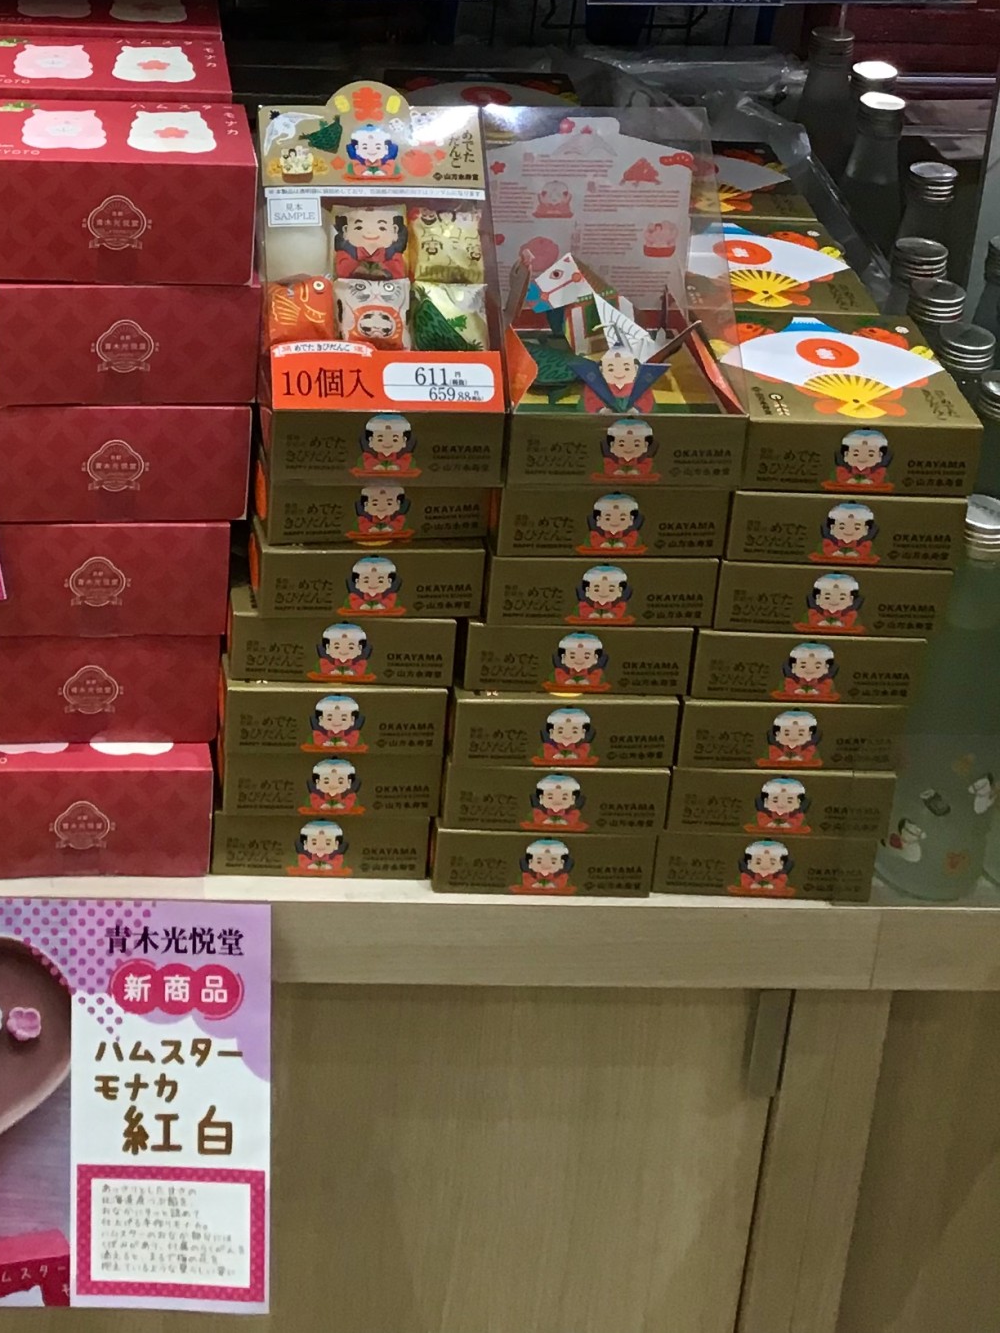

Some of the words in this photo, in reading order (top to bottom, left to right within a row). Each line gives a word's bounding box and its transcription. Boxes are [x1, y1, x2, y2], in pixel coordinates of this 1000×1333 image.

[462, 129, 475, 163] めでた
[286, 203, 303, 211] 見本
[274, 212, 316, 221] SAMPLE
[415, 367, 448, 386] 611
[282, 368, 374, 398] 10個入
[432, 445, 491, 453] OKAYAMA
[673, 449, 732, 458] OKAYAMA
[908, 459, 966, 469] OKAYAMA
[424, 504, 480, 514] OKAYAMA
[659, 522, 715, 531] OKAYAMA
[893, 534, 951, 543] OKAYAMA
[416, 584, 472, 593] OKAYAMA
[646, 594, 703, 602] OKAYAMA
[877, 603, 935, 612] OKAYAMA
[387, 653, 443, 662] OKAYAMA
[623, 661, 679, 670] OKAYAMA
[853, 671, 910, 681] OKAYAMA
[379, 722, 435, 731] OKAYAMA
[609, 735, 664, 744] OKAYAMA
[375, 785, 430, 793] OKAYAMA
[600, 803, 655, 811] OKAYAMA
[362, 847, 417, 856] OKAYAMA
[587, 866, 642, 874] OKAYAMA
[105, 925, 245, 956] 青木光悦堂
[123, 973, 228, 1003] 新商品
[95, 1038, 243, 1068] ハムスター
[94, 1073, 178, 1103] モナカ
[122, 1104, 233, 1156] 紅白
